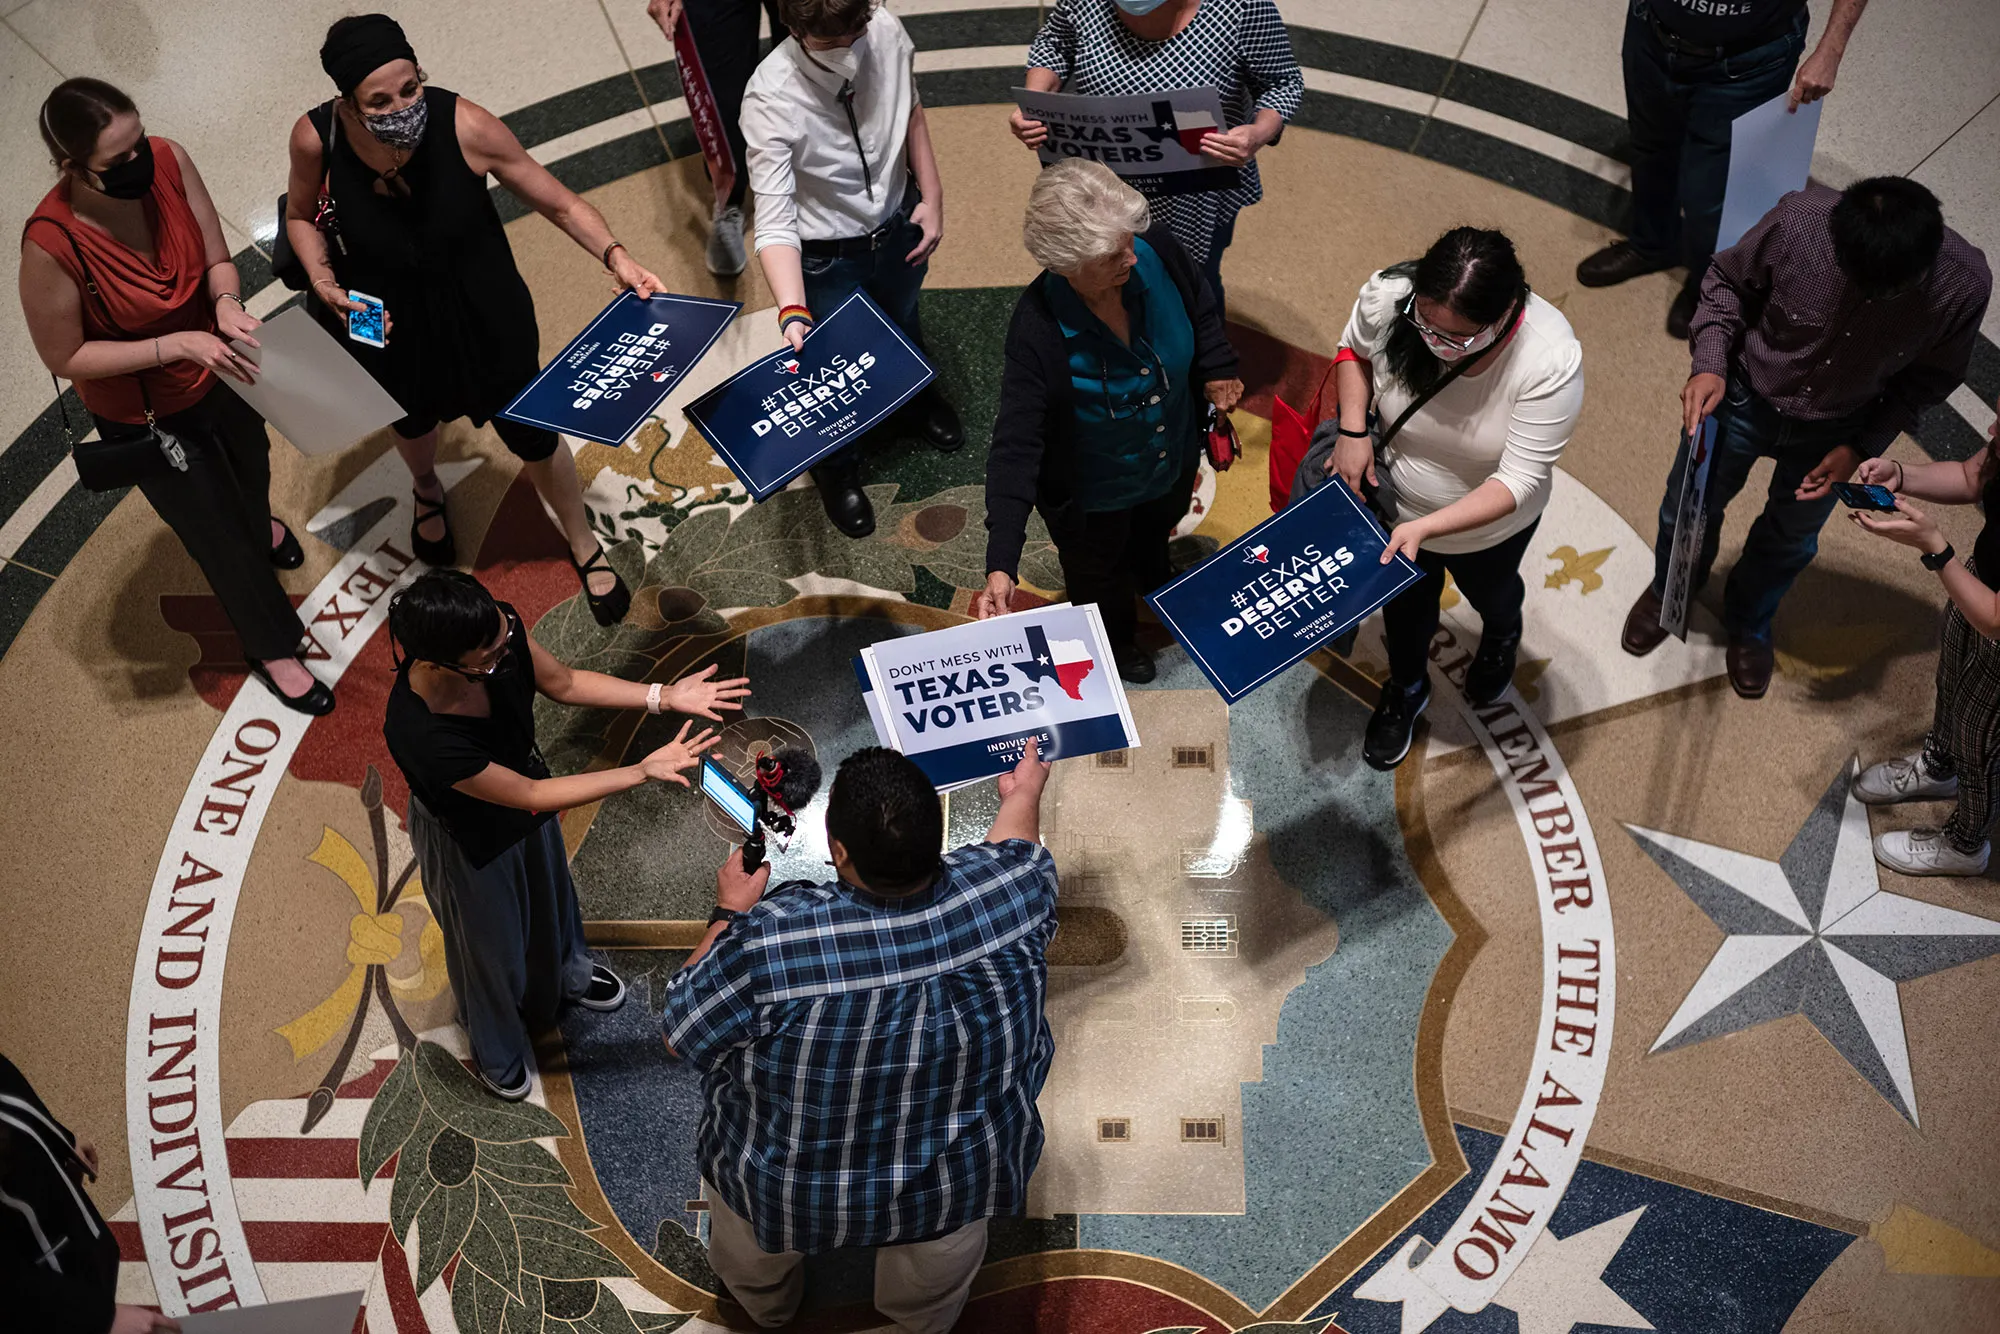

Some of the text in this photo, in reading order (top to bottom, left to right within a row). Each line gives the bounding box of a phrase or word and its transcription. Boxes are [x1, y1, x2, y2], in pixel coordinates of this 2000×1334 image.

[1674, 0, 1751, 16] VISIBLE
[1026, 106, 1148, 124] DON'T MESS WITH
[567, 332, 638, 393] BETTER
[572, 322, 669, 411] DESERVES
[580, 343, 590, 351] TX
[604, 338, 671, 401] #TEXAS
[750, 351, 876, 438] DESERVES
[761, 354, 848, 412] #TEXAS
[781, 378, 872, 438] BETTER
[818, 410, 858, 436] INDIVISIBLE
[828, 419, 857, 438] TX LEGE
[1220, 546, 1355, 637] DESERVES
[1230, 543, 1322, 609] #TEXAS
[1253, 576, 1350, 640] BETTER
[1293, 610, 1335, 638] INDIVISIBLE
[1304, 619, 1335, 640] TX LEGE
[888, 643, 1024, 679] DON'T MESS WITH
[894, 663, 1010, 705] TEXAS
[902, 686, 1045, 734] VOTERS
[987, 733, 1049, 752] INDIVISLE
[1000, 747, 1044, 763] TX LE
[147, 538, 419, 1316] TEXA ONE AND INDIVISI
[1551, 938, 1601, 1057] THE
[1453, 1070, 1583, 1281] ALAMO
